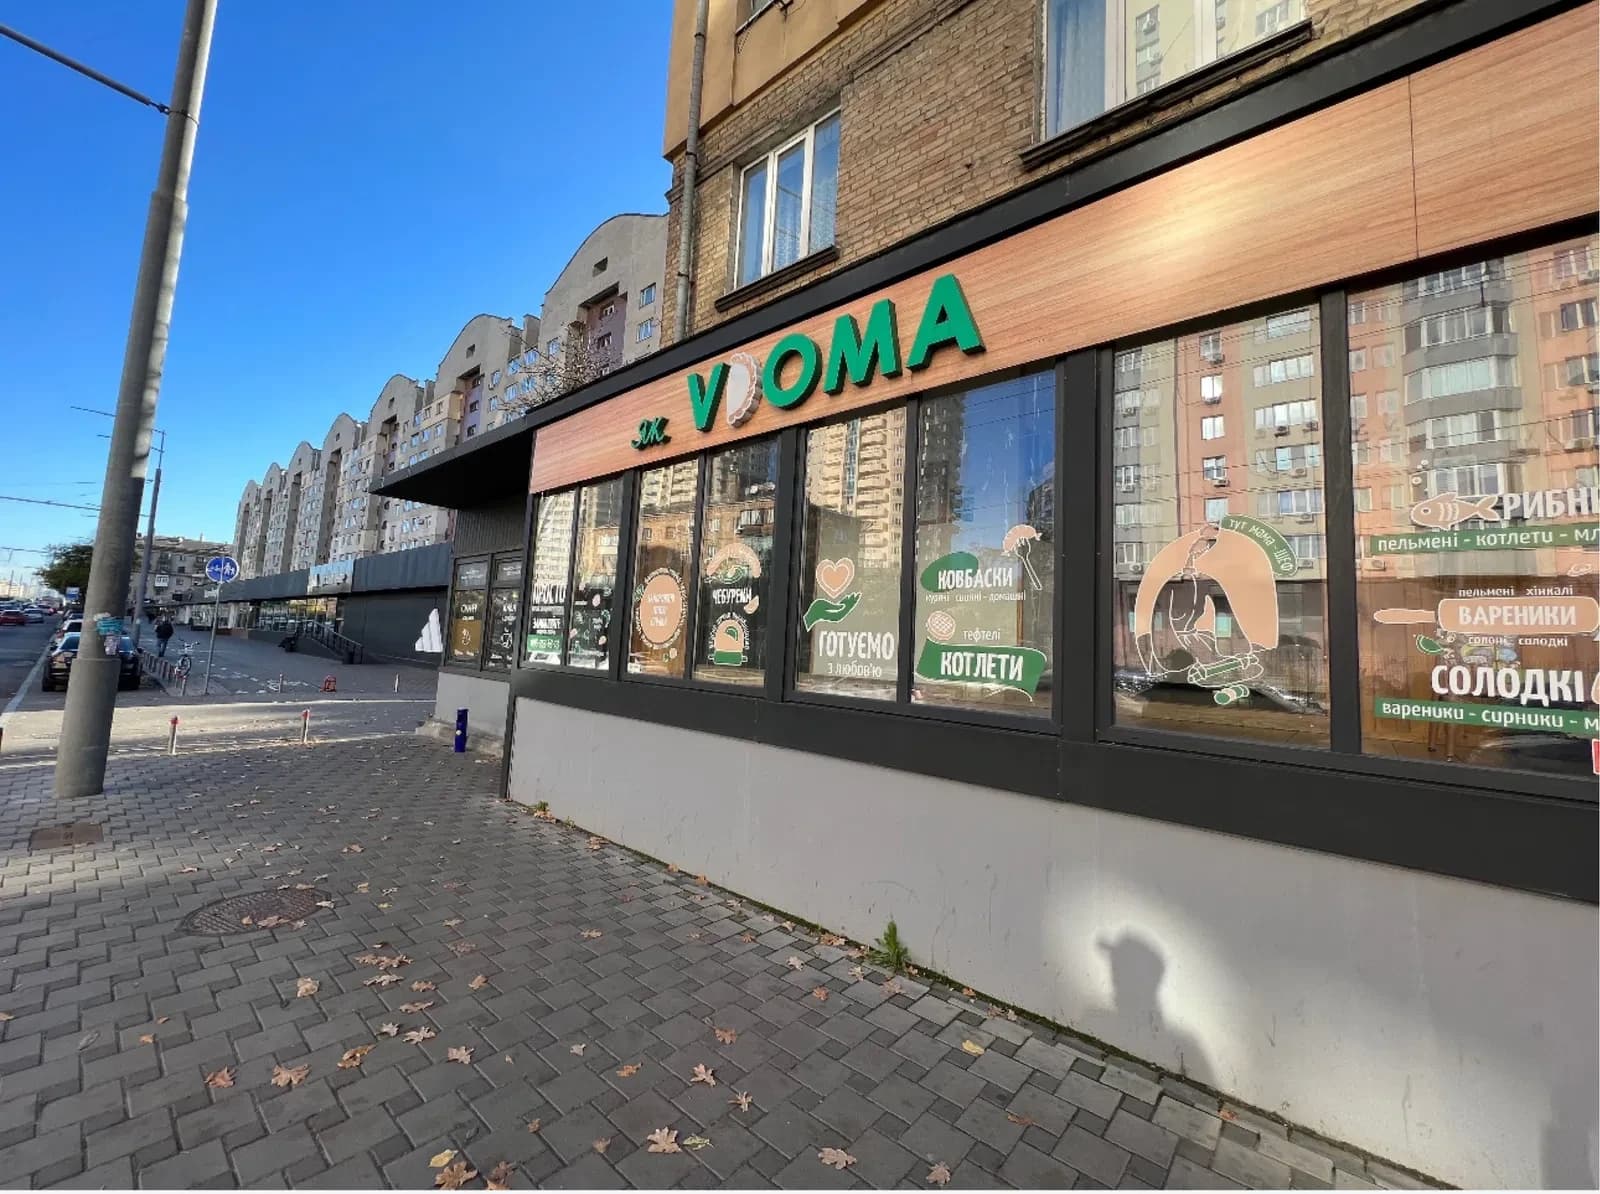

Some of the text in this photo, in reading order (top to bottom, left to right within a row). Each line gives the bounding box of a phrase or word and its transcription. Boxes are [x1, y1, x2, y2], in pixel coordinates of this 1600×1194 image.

[1248, 525, 1275, 547] мама
[1378, 533, 1458, 552] пельмені
[1476, 531, 1554, 547] котлети
[938, 567, 1013, 590] КОВБАСКИ
[712, 587, 752, 605] ЧЕБУРЕКИ
[989, 590, 1026, 604] домашні
[1458, 585, 1573, 598] пельмені хінкалі
[1458, 605, 1577, 626] ВАРЕНИКИ
[818, 630, 895, 661] ГОТУЄМО
[962, 627, 1001, 643] тефтелі
[1518, 636, 1568, 648] солодкі
[834, 660, 882, 678] любов'ю
[940, 651, 1023, 682] КОТЛЕТИ
[1431, 665, 1585, 706] СОЛОДКІ
[1382, 702, 1464, 721] вареники
[1481, 708, 1564, 728] сирники
